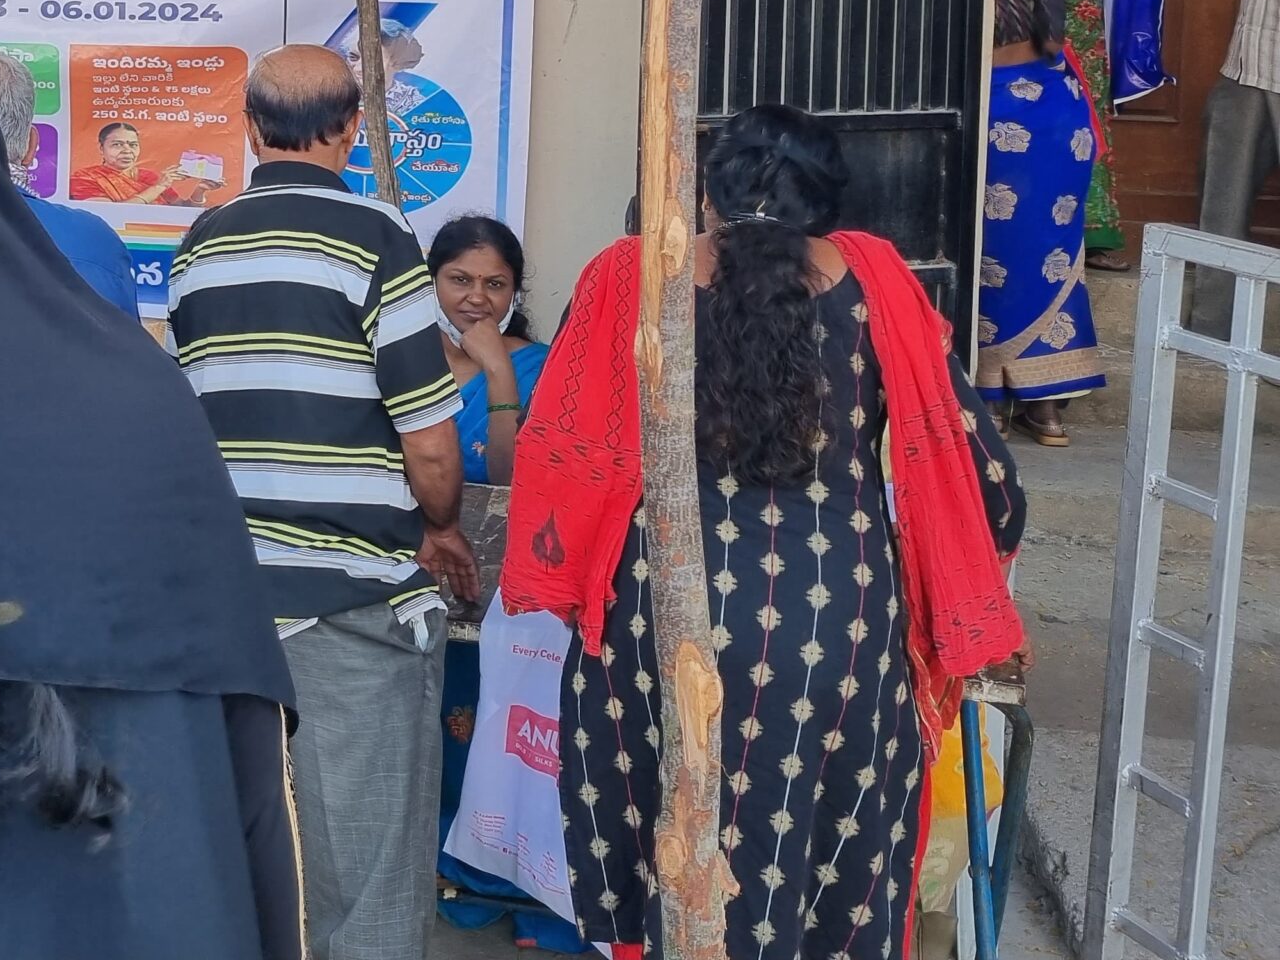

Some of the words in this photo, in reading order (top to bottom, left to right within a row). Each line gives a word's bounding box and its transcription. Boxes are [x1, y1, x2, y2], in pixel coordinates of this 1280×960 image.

[40, 0, 223, 22] 06.01.2024
[92, 56, 173, 72] ఇందిరమ్మ
[92, 110, 118, 119] 250
[155, 110, 190, 122] ఇంటి
[193, 111, 228, 127] స్థలం
[512, 644, 539, 658] Every
[540, 649, 562, 664] Cele
